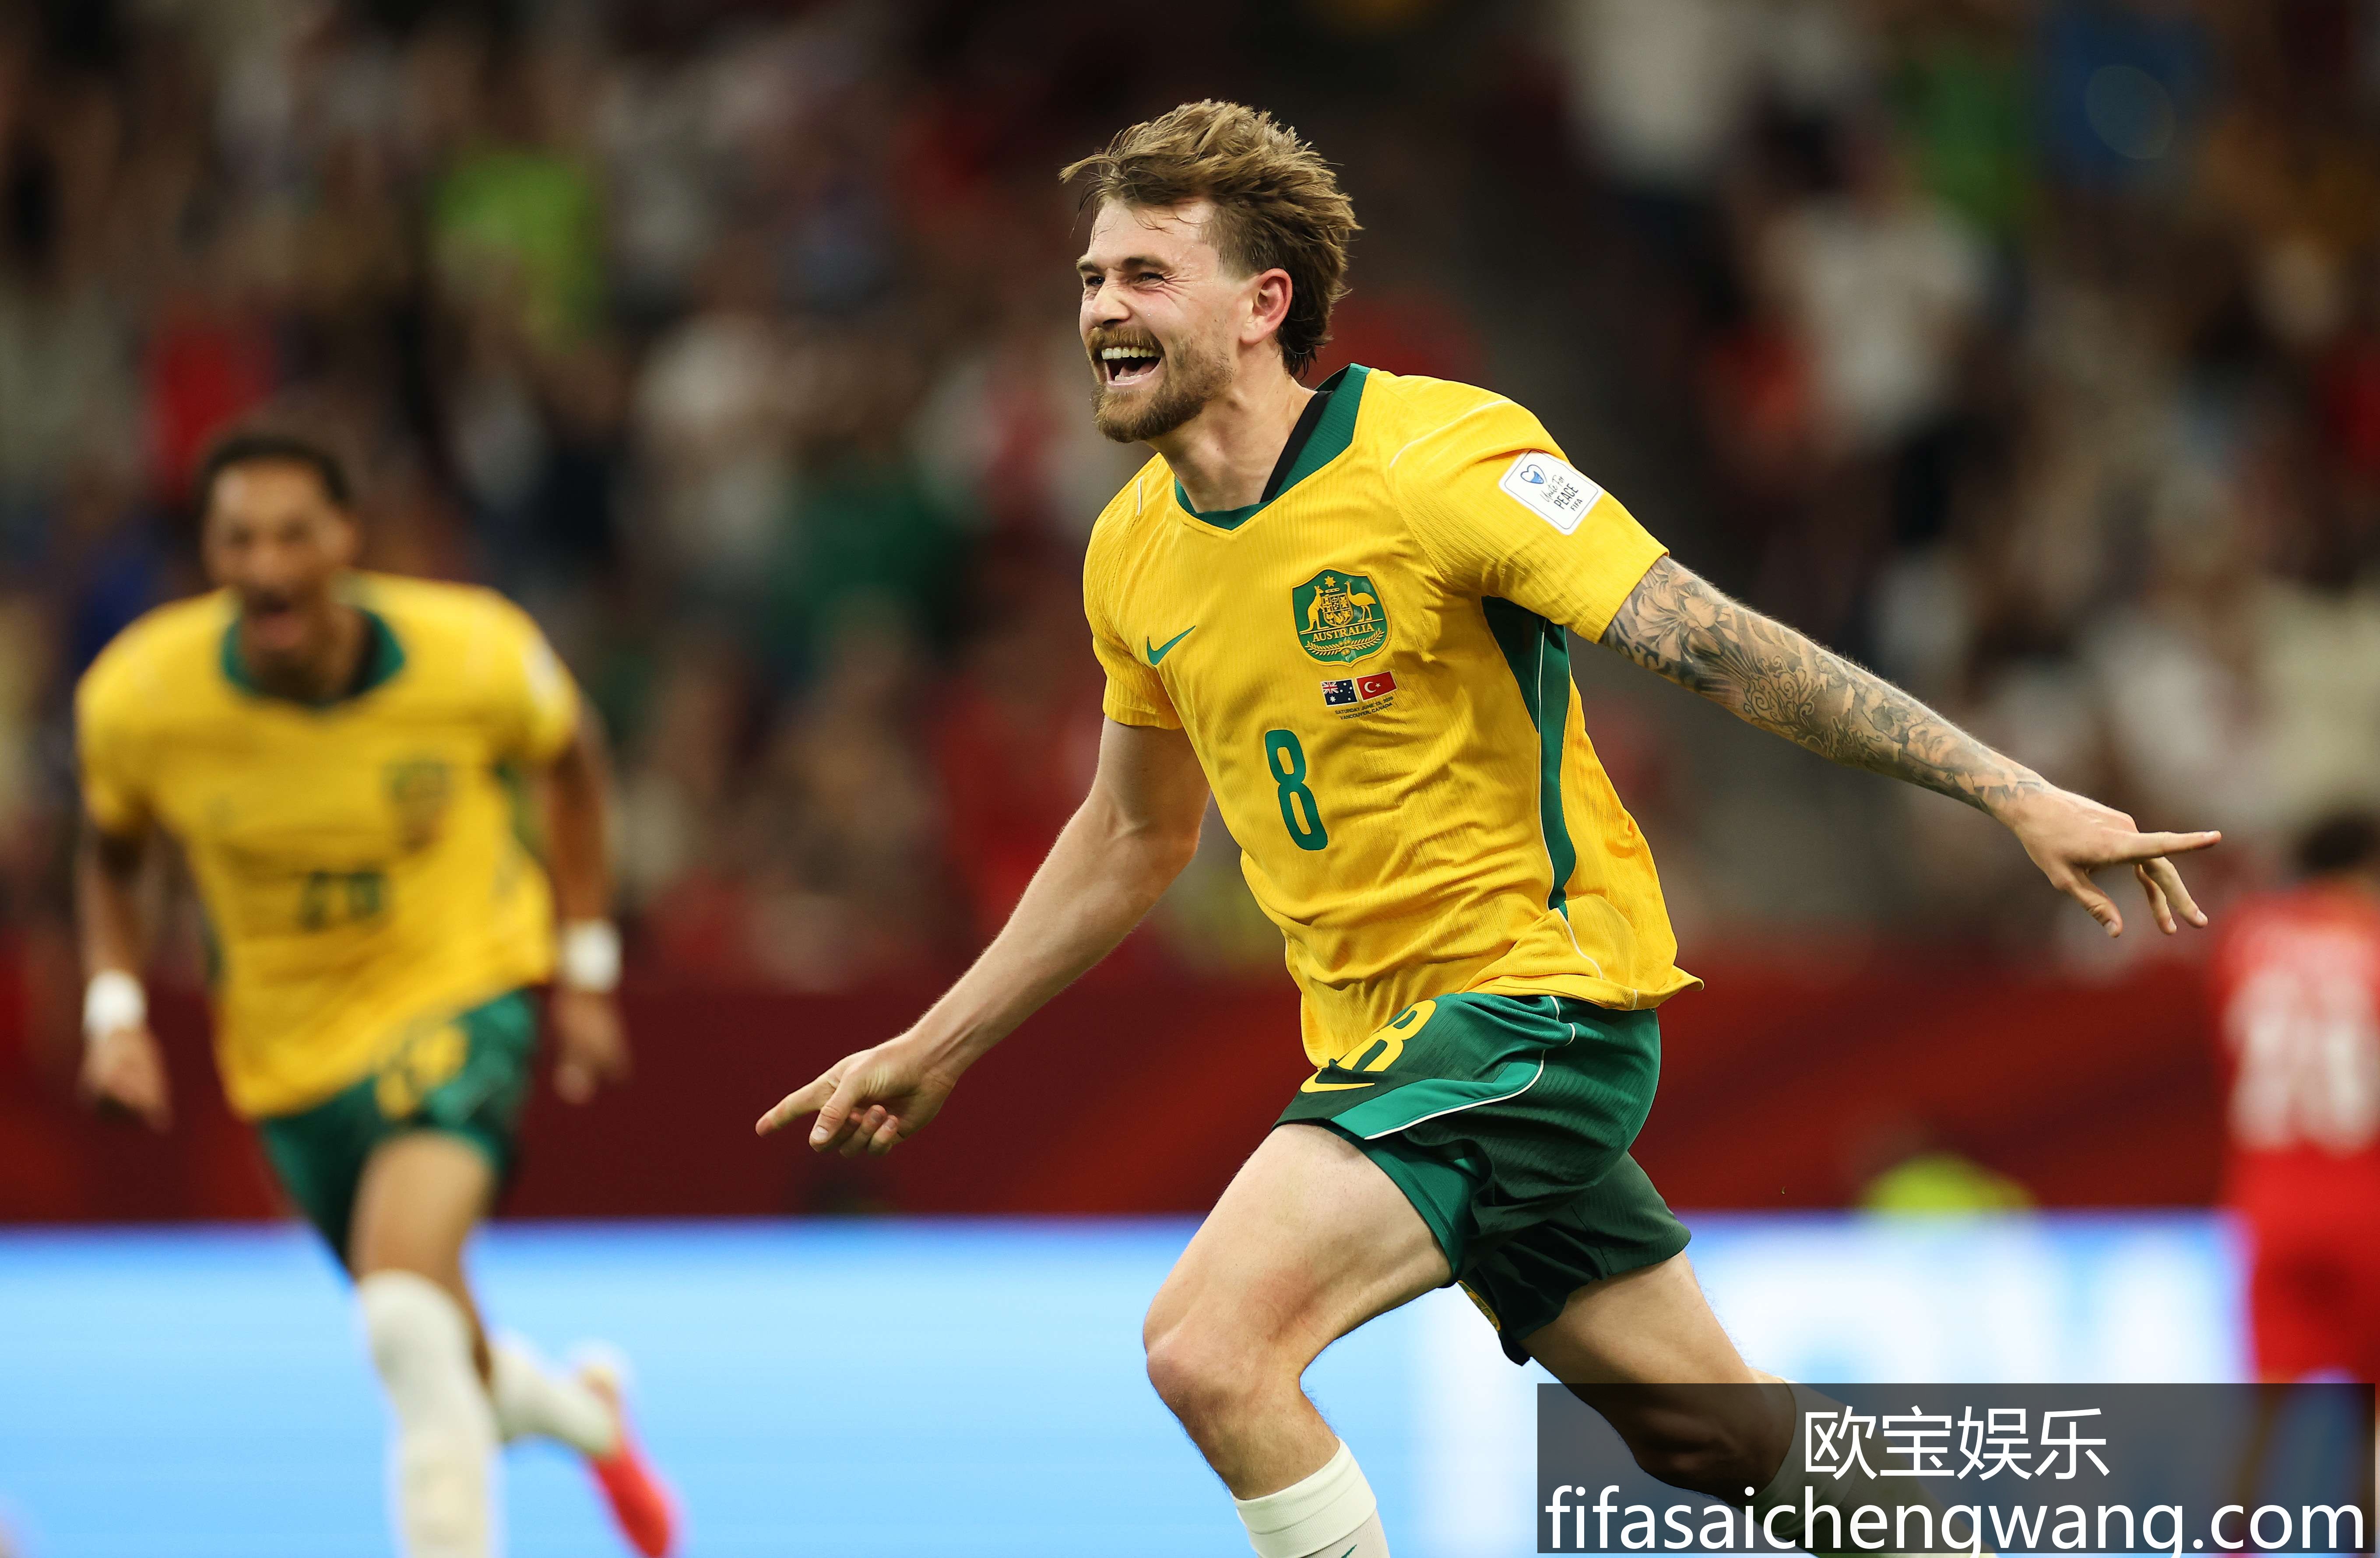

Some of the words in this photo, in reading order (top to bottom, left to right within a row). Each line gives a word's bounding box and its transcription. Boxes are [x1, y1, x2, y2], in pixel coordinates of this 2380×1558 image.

[1554, 483, 1578, 509] PEACE
[1570, 499, 1582, 511] FIFA
[1312, 623, 1375, 642] AUSTRALIA
[1371, 702, 1392, 713] CANADA
[1265, 729, 1328, 851] 8
